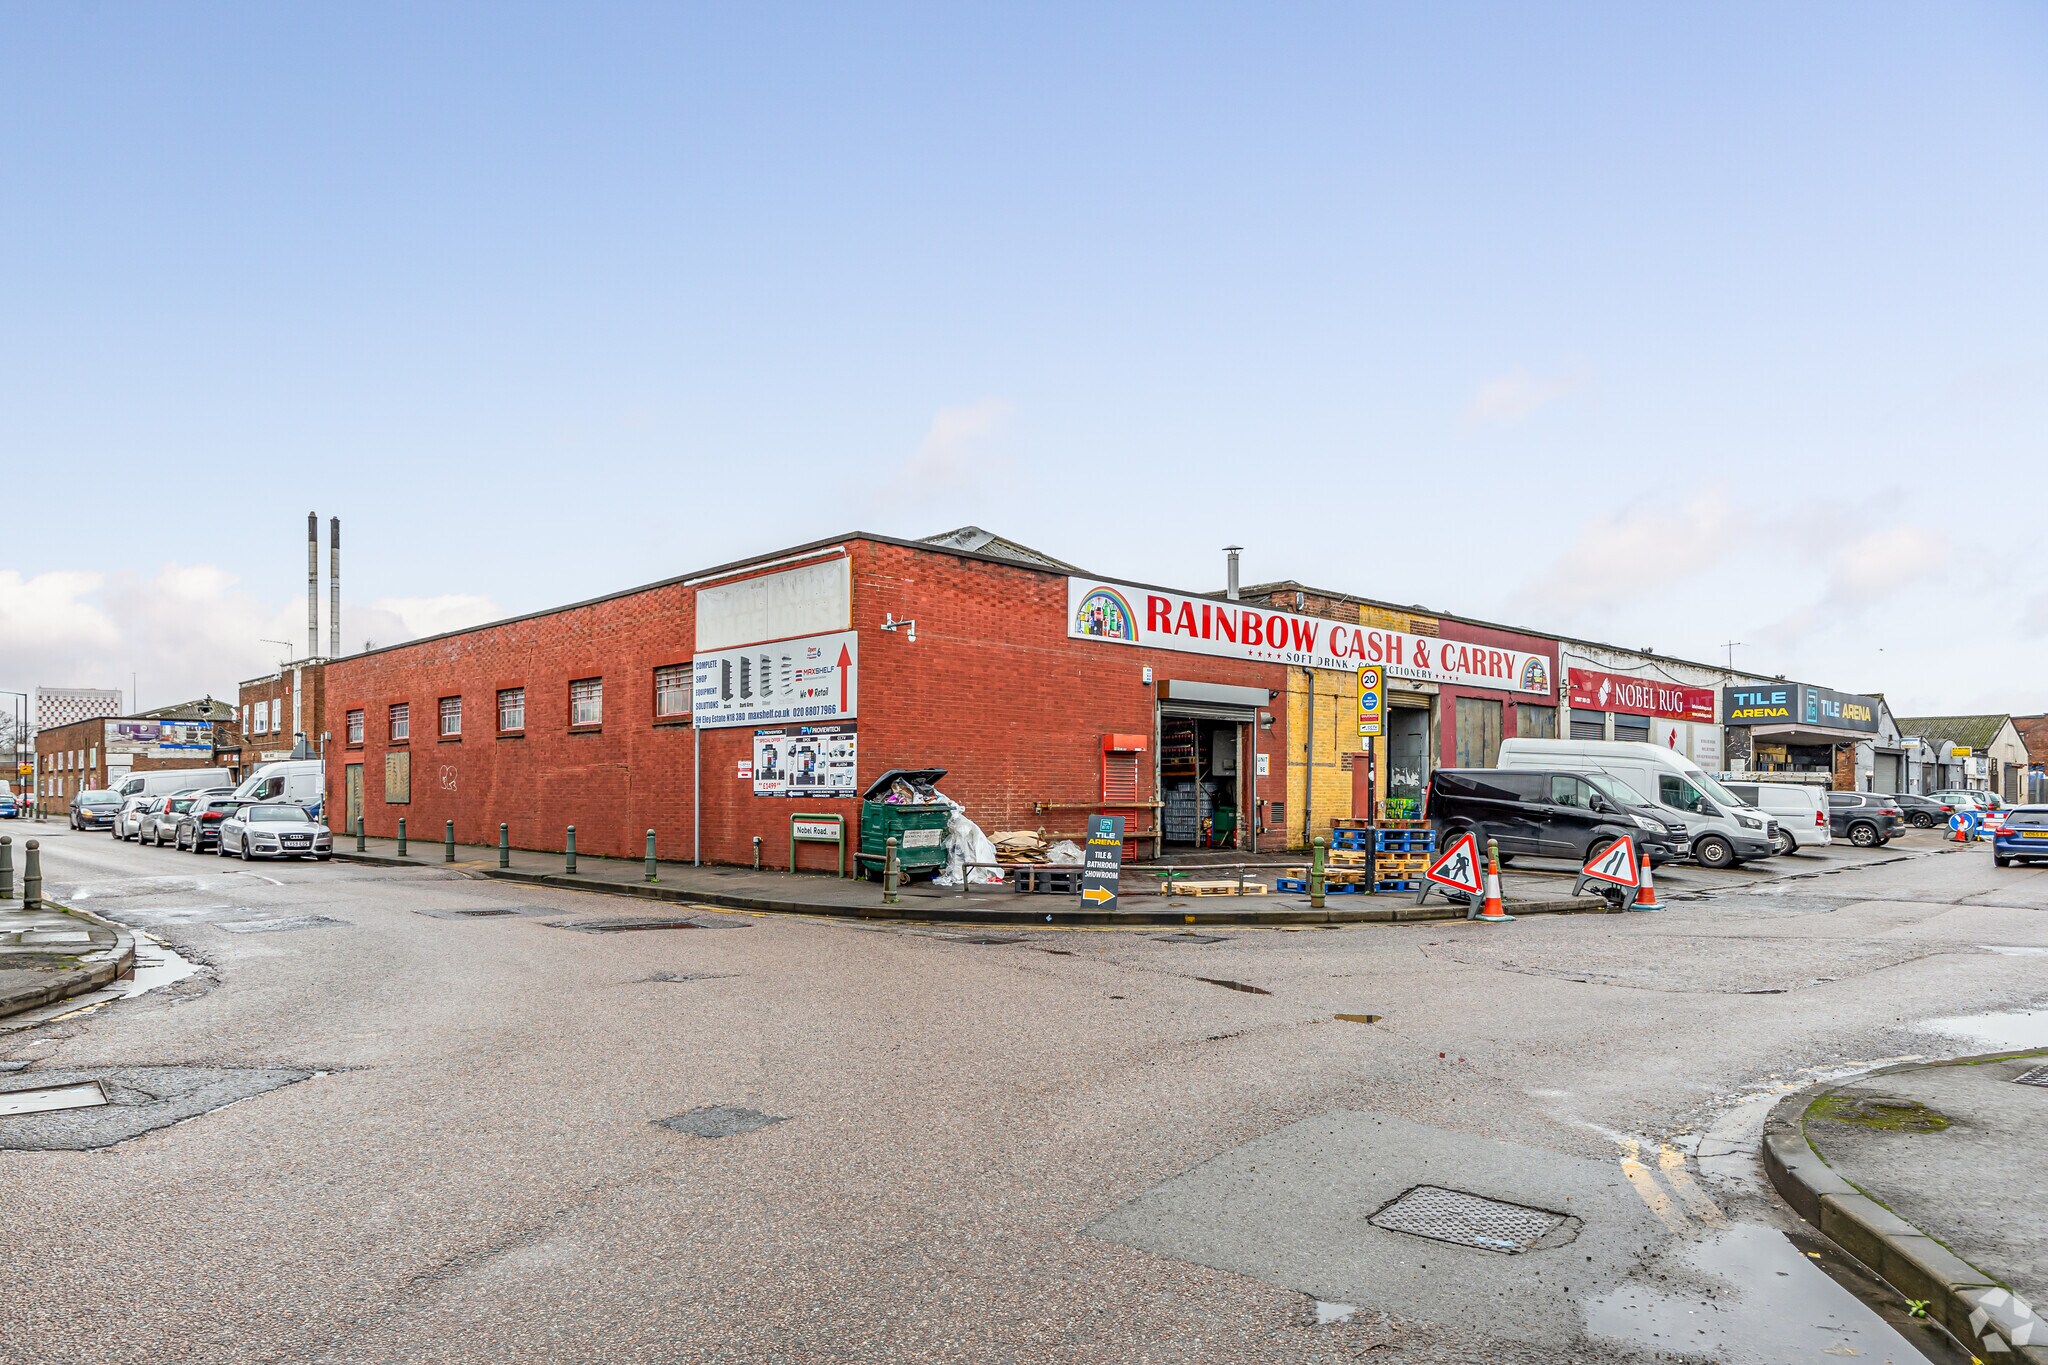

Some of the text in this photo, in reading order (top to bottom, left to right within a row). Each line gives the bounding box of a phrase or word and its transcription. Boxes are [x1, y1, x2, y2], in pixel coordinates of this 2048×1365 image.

[1146, 595, 1516, 680] RAINBOW CASH & CARRY
[696, 660, 718, 670] COMPLETE
[1286, 651, 1313, 666] SOFT
[1317, 656, 1349, 670] DRINK
[803, 665, 835, 675] MAXSHELF
[696, 675, 708, 683] SHOP
[1364, 675, 1376, 684] 20
[696, 687, 718, 696] EQUIPMENT
[800, 687, 829, 698] We Retail
[1615, 683, 1684, 713] NOBEL RUG
[1733, 691, 1787, 705] TILE
[696, 701, 719, 710] SOLUTIONS
[712, 714, 726, 722] Estate
[748, 708, 790, 719] maxshelf.co.uk
[793, 707, 804, 717] 020
[805, 706, 820, 716] 8807
[821, 704, 837, 715] 7966
[1731, 707, 1789, 719] ARENA
[1821, 700, 1840, 718] TILE
[1842, 703, 1872, 722] ARENA
[797, 826, 813, 835] Nobel
[1095, 851, 1106, 859] TILE
[1087, 861, 1119, 870] BATHROOM
[1085, 870, 1118, 879] SHOWROOM
